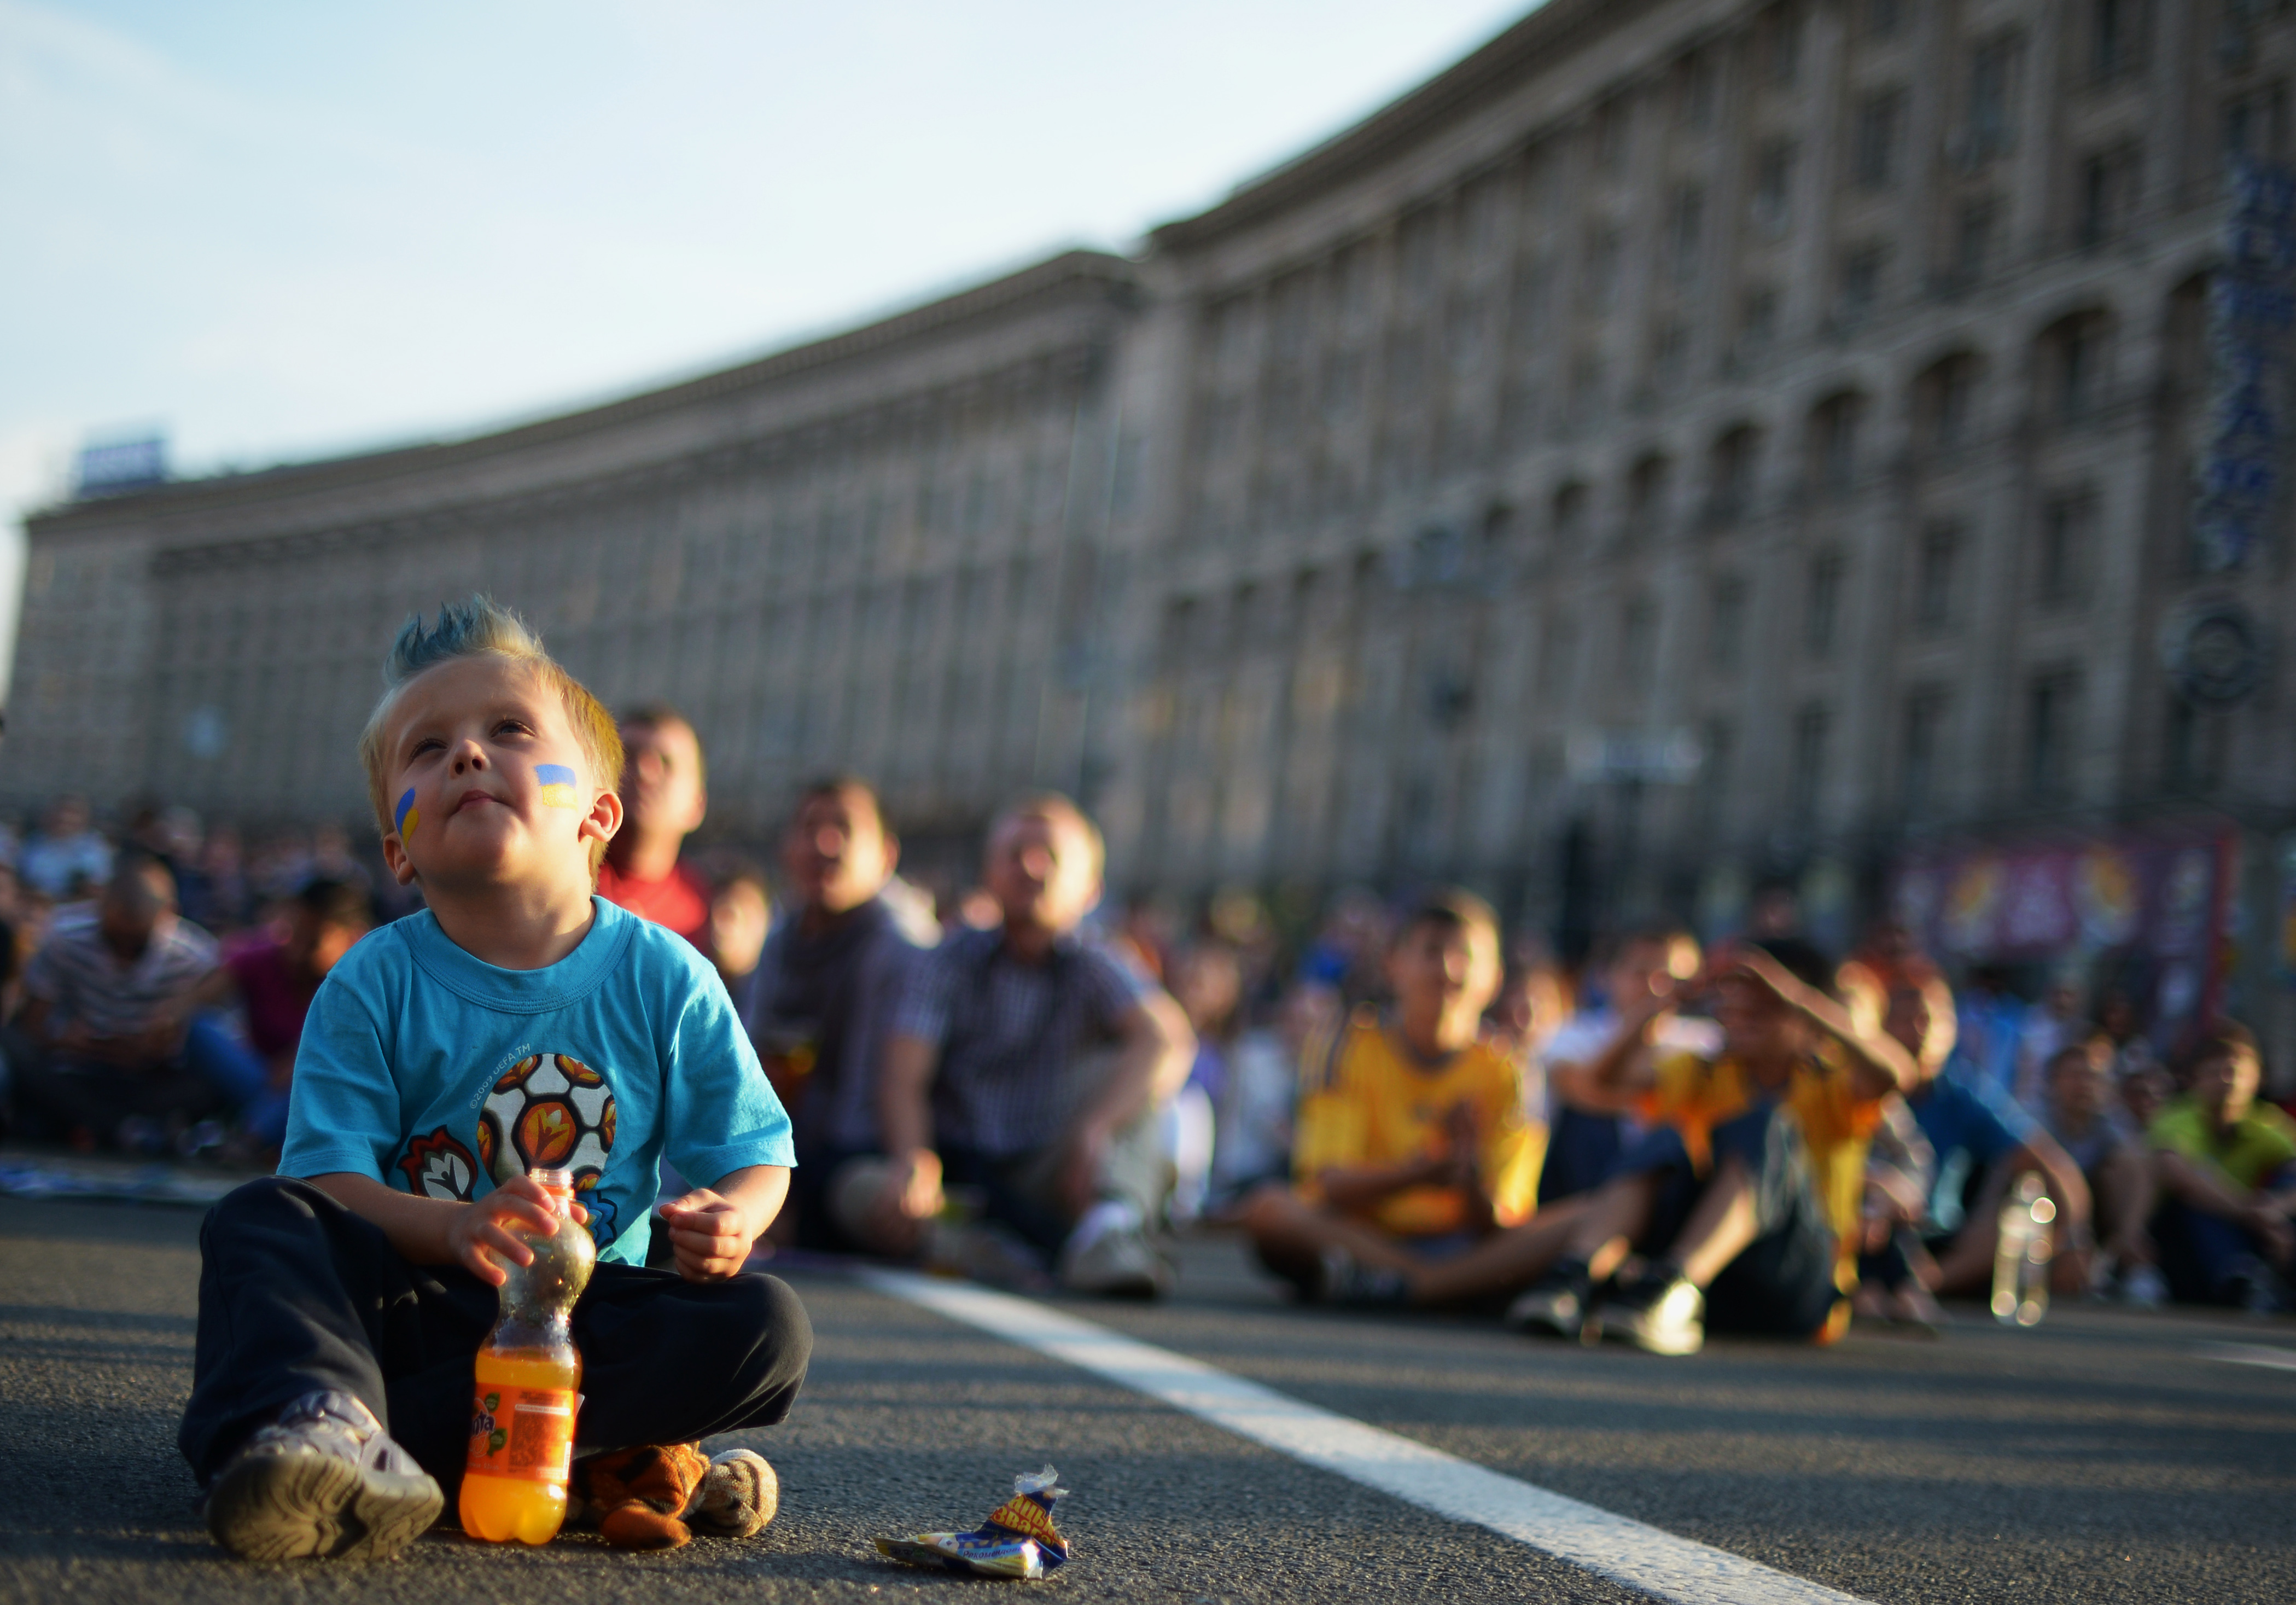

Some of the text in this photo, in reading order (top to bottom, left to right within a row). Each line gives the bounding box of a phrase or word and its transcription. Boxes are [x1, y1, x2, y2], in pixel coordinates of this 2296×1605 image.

[470, 1043, 530, 1109] ©2009 UEFA TM
